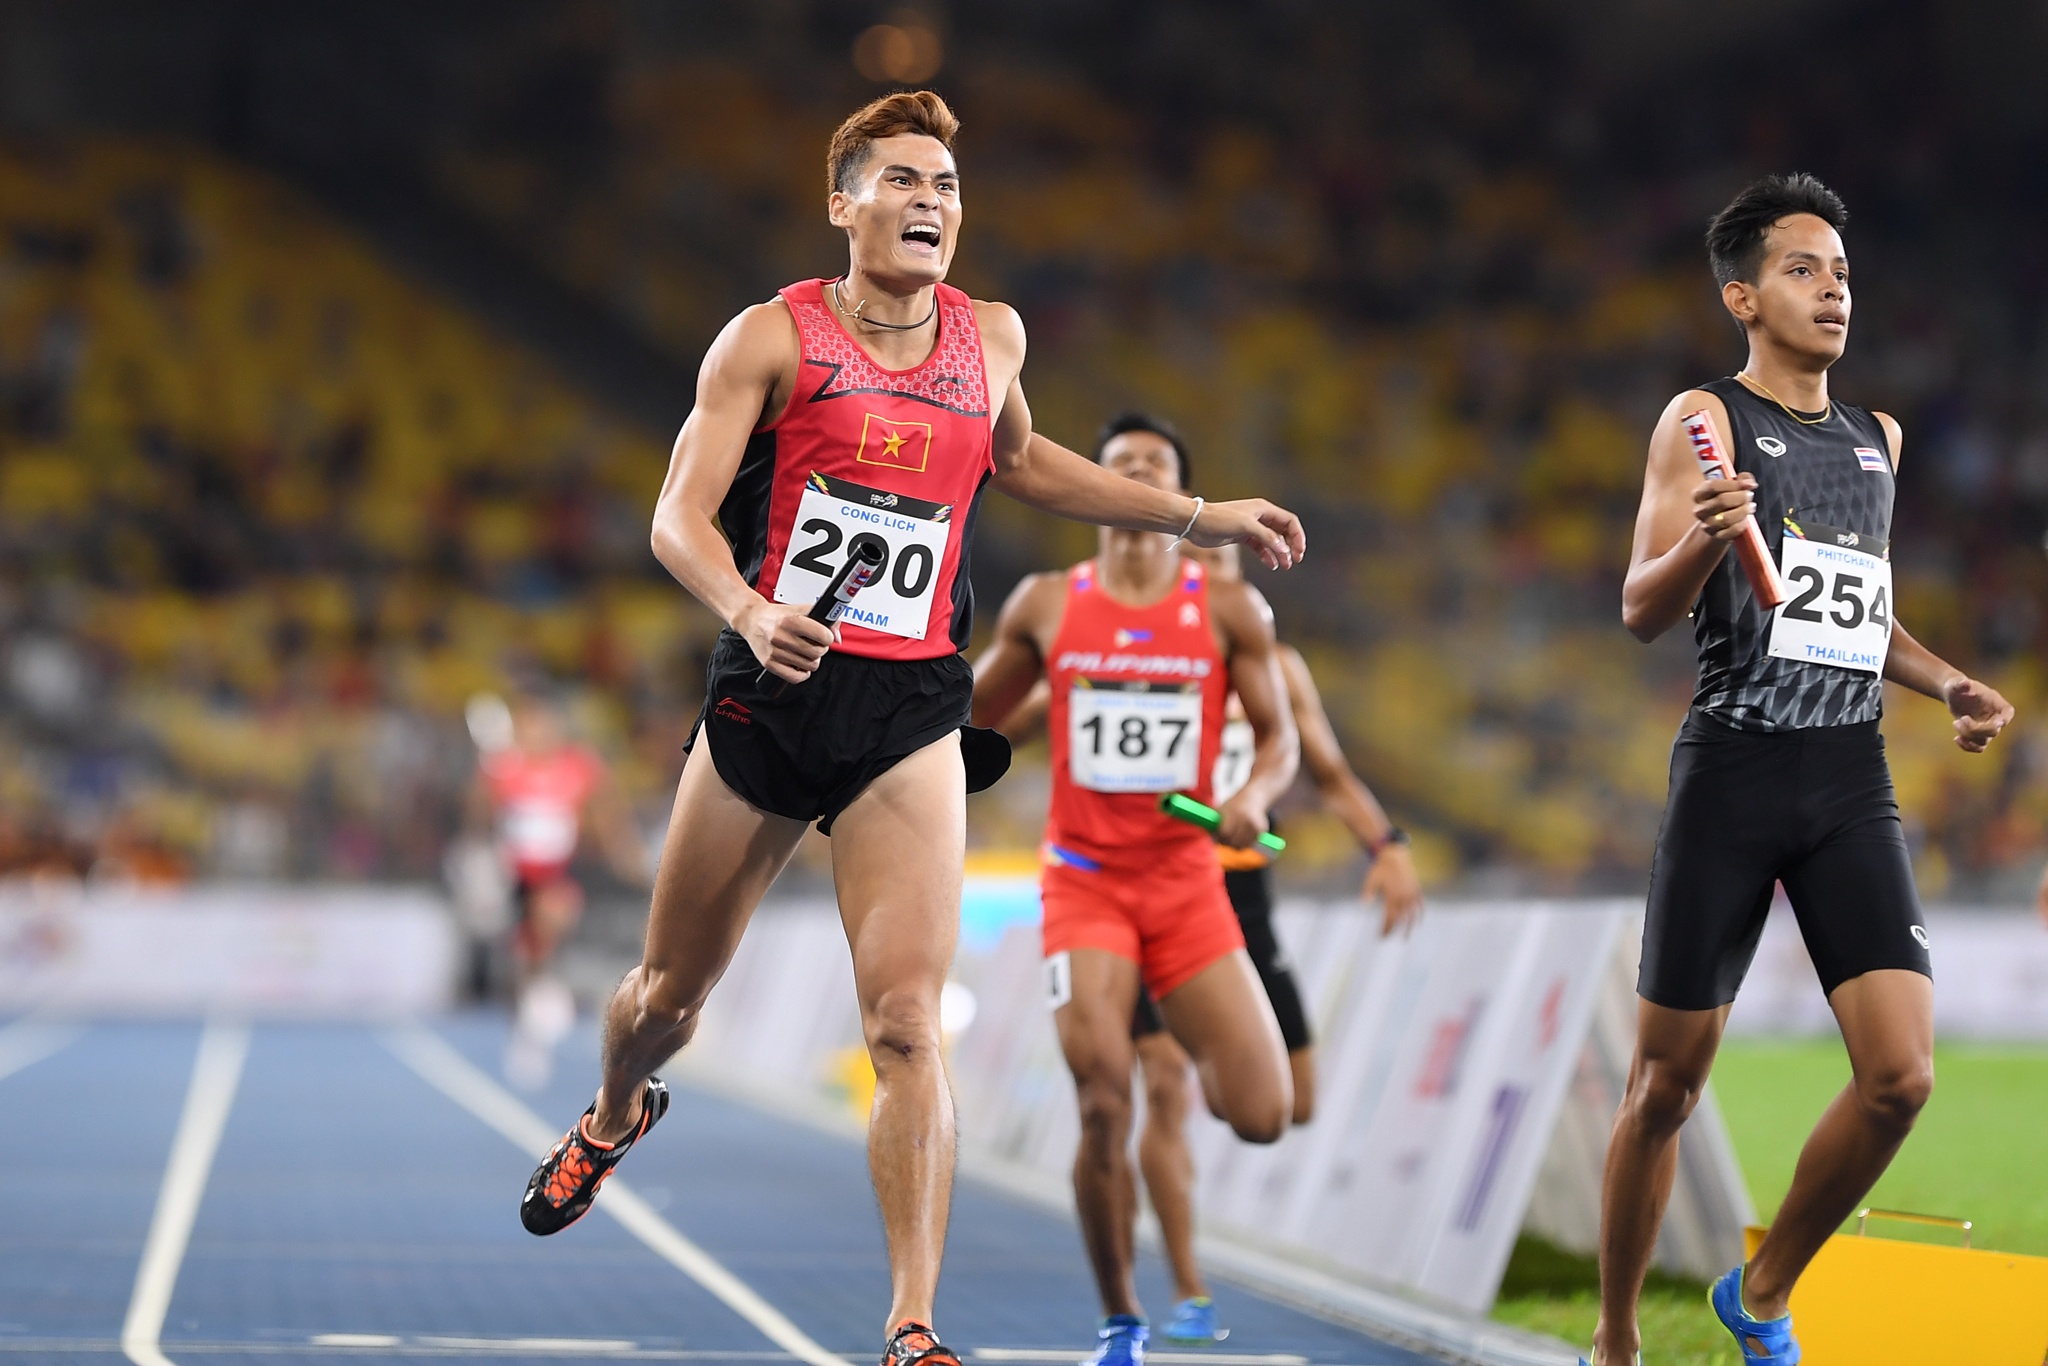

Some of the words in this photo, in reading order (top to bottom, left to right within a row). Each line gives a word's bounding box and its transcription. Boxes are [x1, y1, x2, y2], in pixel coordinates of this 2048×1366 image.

[841, 506, 880, 524] CONG
[884, 518, 916, 532] LICH
[1817, 548, 1875, 569] PHITCHAYA
[1781, 565, 1889, 638] 254
[1806, 645, 1879, 666] THAILAND
[1082, 714, 1190, 758] 187
